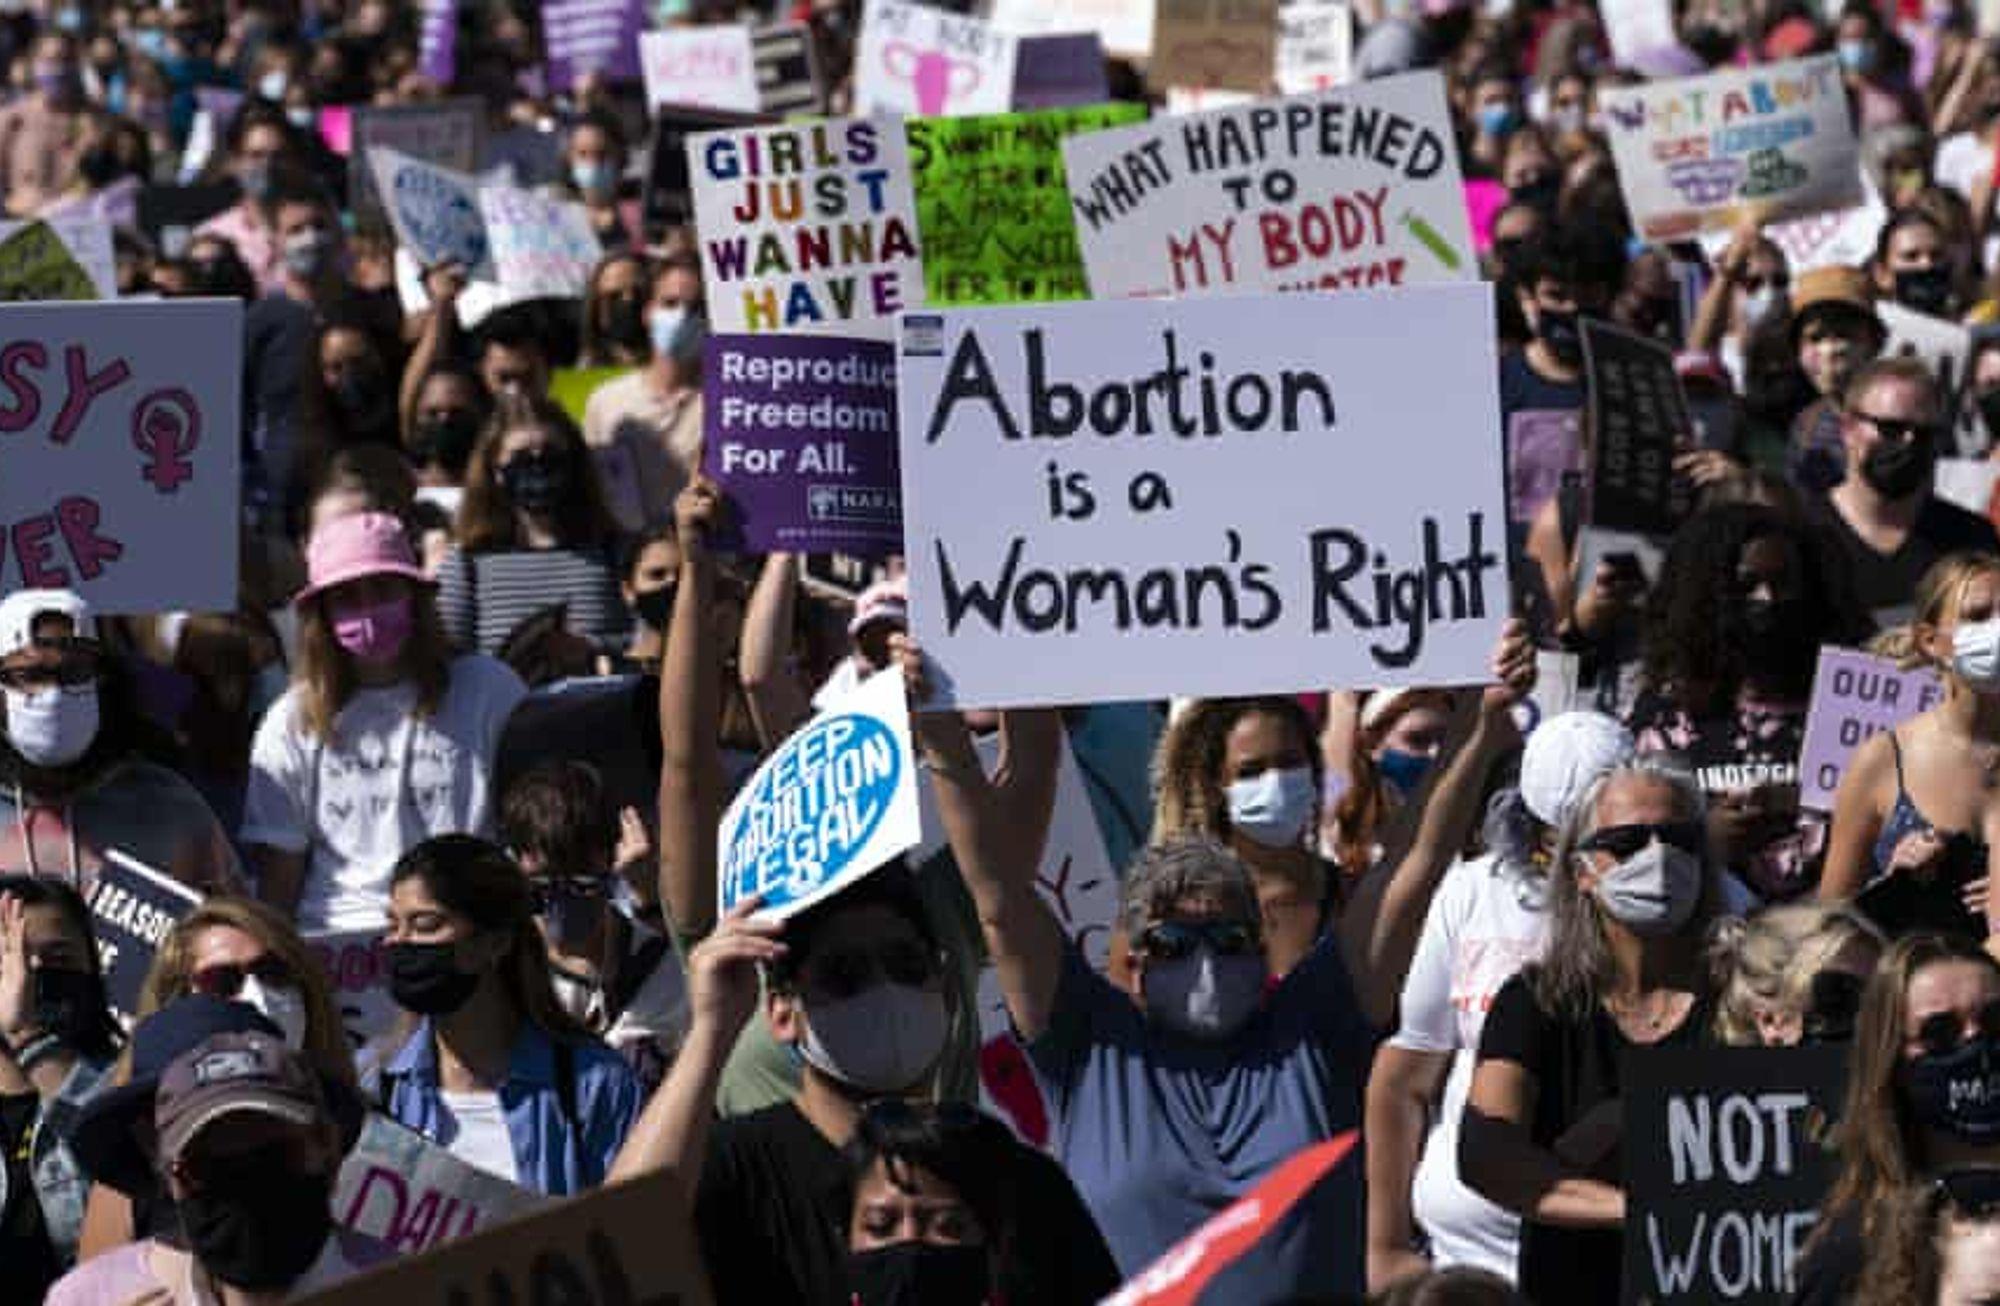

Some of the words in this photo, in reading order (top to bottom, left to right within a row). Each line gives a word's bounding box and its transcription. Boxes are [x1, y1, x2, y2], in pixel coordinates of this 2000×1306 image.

[706, 121, 877, 180] GIRLS
[1074, 137, 1172, 231] WHAT
[1182, 101, 1445, 180] HAPPENED
[734, 169, 889, 222] JUST
[1222, 169, 1297, 210] TO
[709, 217, 917, 282] WANNA
[1167, 216, 1236, 291] MY
[1259, 186, 1389, 270] BODY
[743, 270, 904, 330] HAVE
[720, 396, 888, 432] Freedom
[927, 329, 1335, 444] Abortion
[720, 443, 785, 473] For
[796, 441, 857, 474] All.
[1046, 459, 1096, 520] is
[1127, 471, 1173, 513] a
[935, 529, 1283, 636] Woman's
[1309, 511, 1498, 669] Right
[1832, 667, 1901, 708] OUR
[1668, 1093, 1809, 1184] NOT
